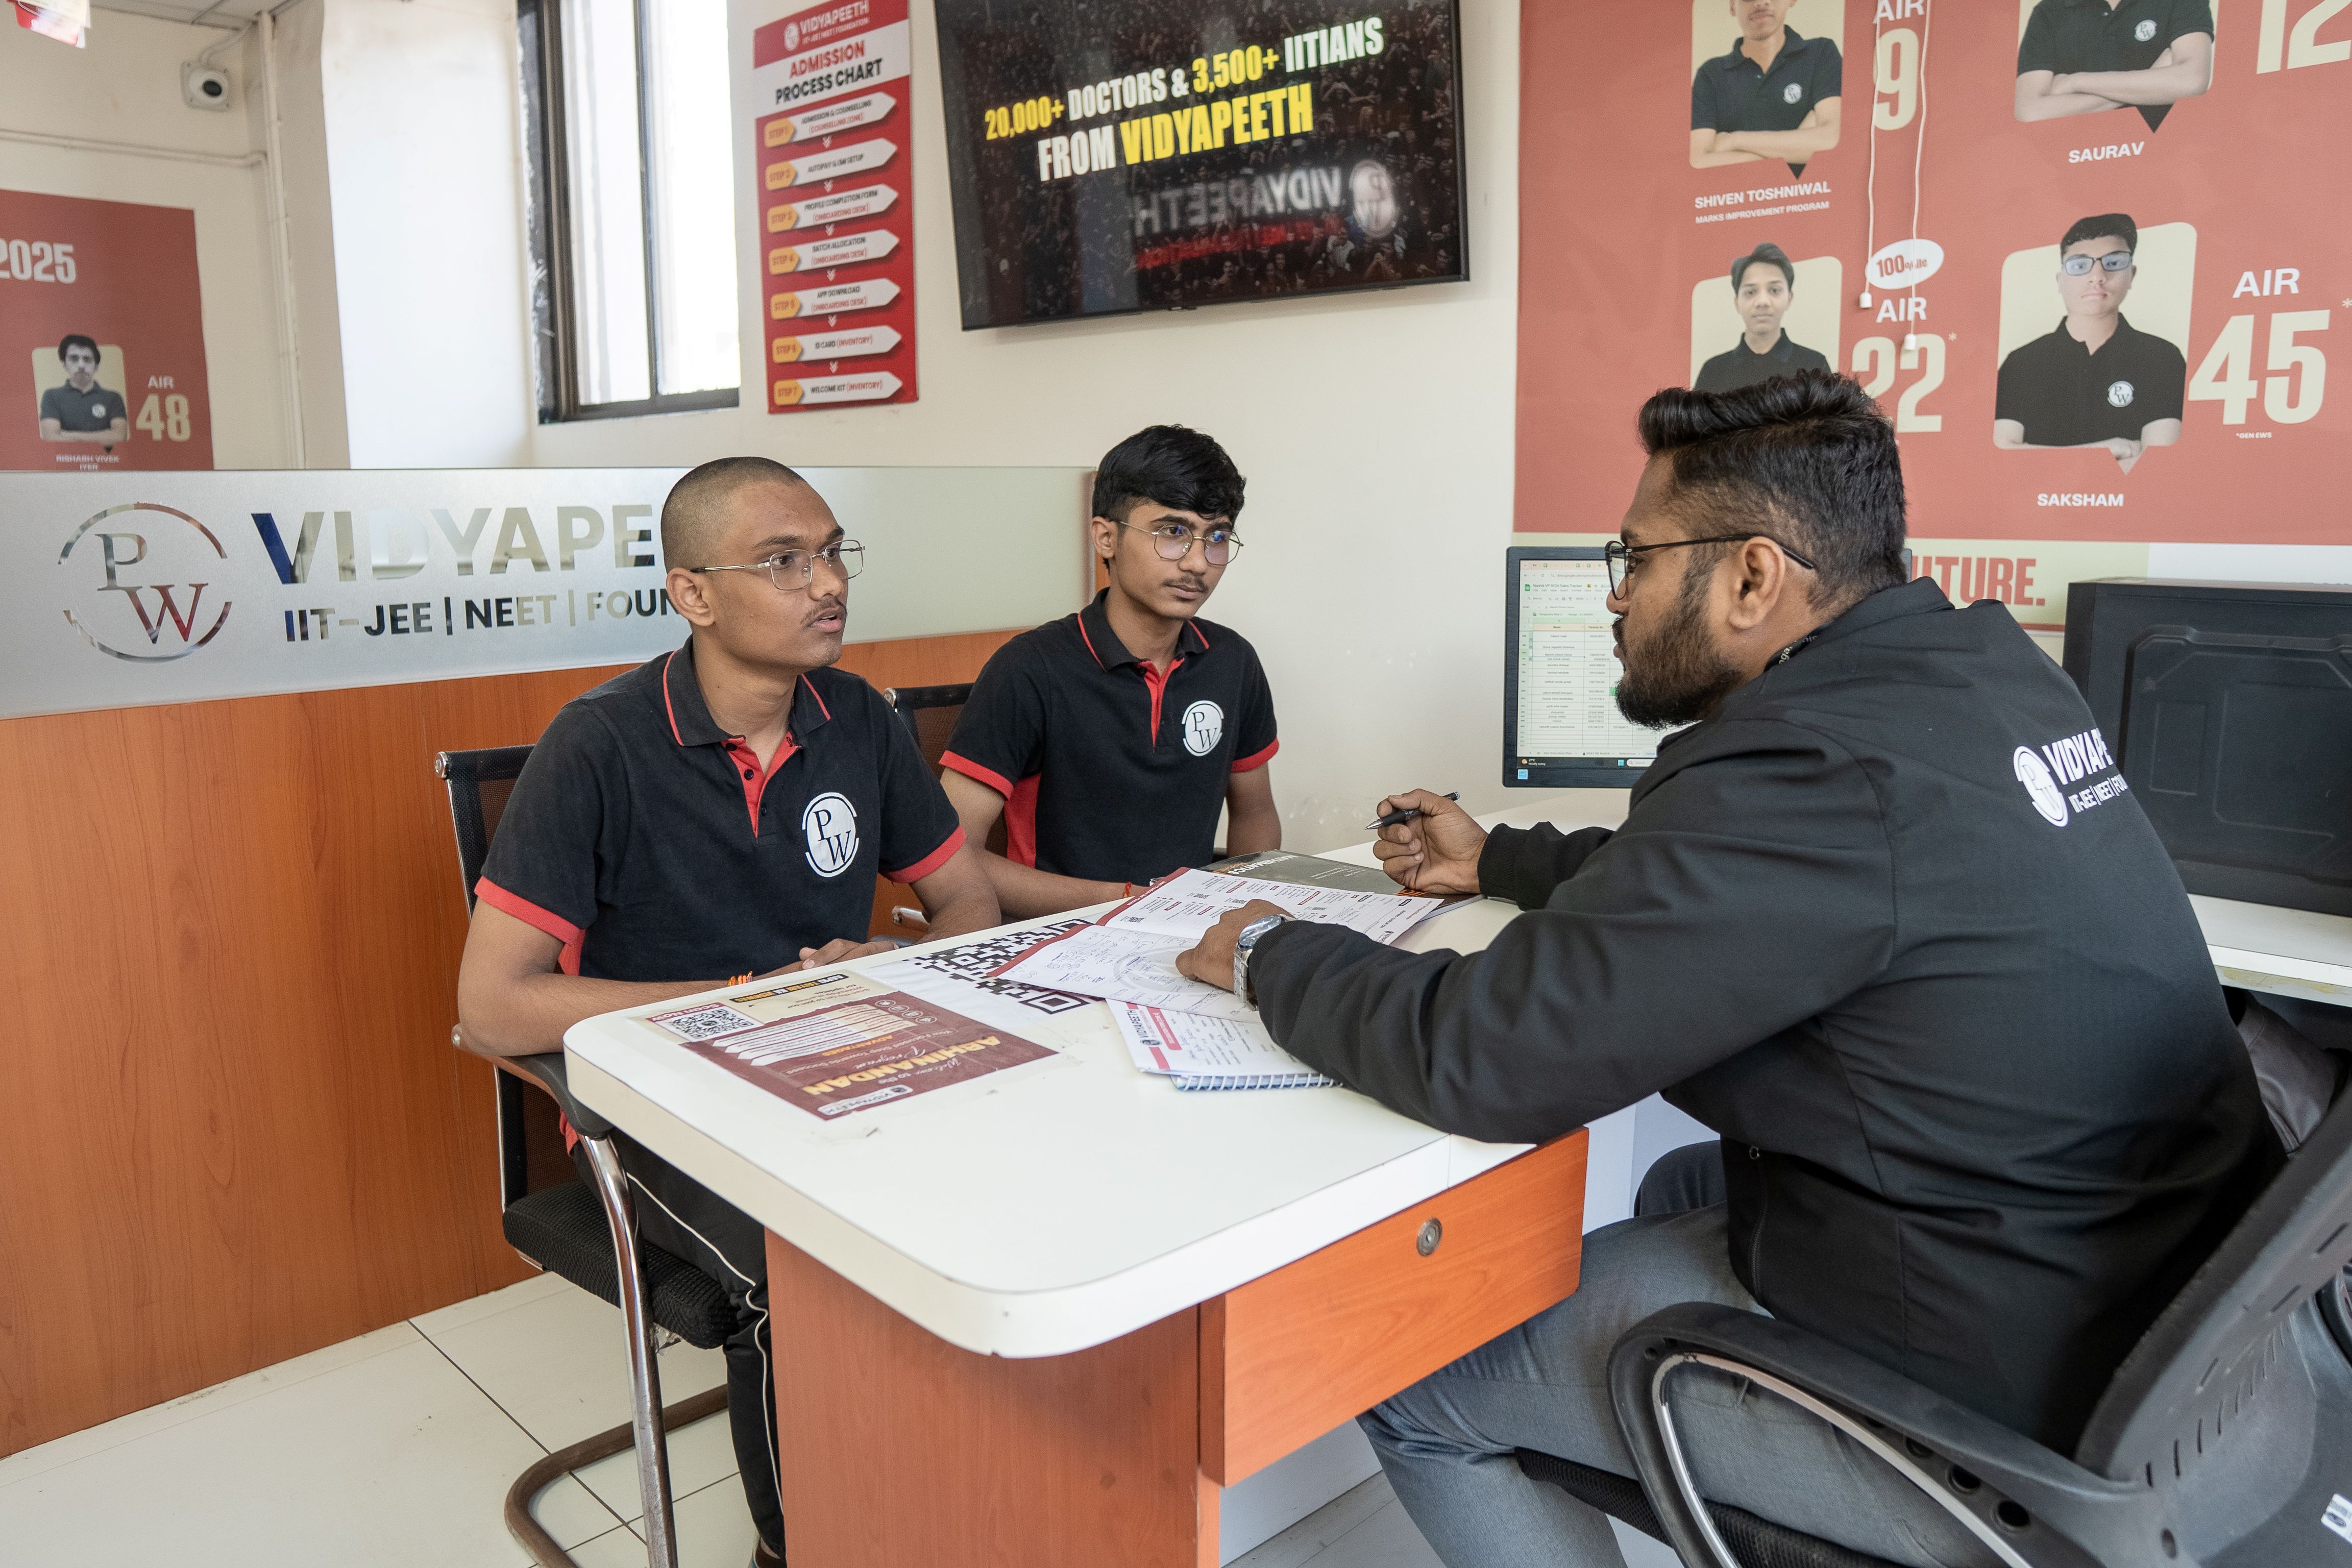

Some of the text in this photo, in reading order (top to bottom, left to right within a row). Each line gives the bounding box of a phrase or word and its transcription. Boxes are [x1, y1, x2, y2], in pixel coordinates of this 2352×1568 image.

[800, 1, 870, 34] VIDYAPEETH
[1873, 0, 1925, 23] AIR
[2256, 0, 2352, 75] 12
[790, 40, 865, 79] ADMISSION
[775, 58, 883, 105] PROCESS CHART
[985, 17, 1384, 140] 20,000+ DOCTORS & 3,500+ IITIANS
[1873, 28, 1919, 131] 9
[835, 100, 872, 115] COUNSELLING
[768, 129, 785, 139] STEP
[1038, 83, 1314, 182] FROM VIDYAPEETH
[2068, 141, 2145, 164] SAURAV
[769, 170, 785, 182] STEP
[1695, 181, 1831, 209] SHIVEN TOSHNIWAL
[770, 213, 786, 225] STEP
[1695, 201, 1830, 224] MARKS IMPROVEMENT PROGRAM
[830, 237, 866, 249] ALLOCATION
[772, 255, 788, 266] STEP
[2232, 268, 2300, 299] AIR
[774, 301, 790, 311] STEP
[1876, 297, 1927, 324] AIR
[776, 345, 791, 355] STEP
[821, 339, 836, 349] CARD
[837, 333, 874, 348] (INVENTORY)
[148, 376, 174, 389] AIR
[778, 388, 792, 398] STEP
[810, 385, 836, 394] WELCOME
[846, 380, 883, 393] (INVENTORY)
[136, 394, 191, 442] 48
[2037, 493, 2124, 508] SAKSHAM
[251, 504, 663, 585] VIDYAPE
[284, 601, 433, 642] IIT-JEE
[465, 594, 557, 630] NEET
[1228, 854, 1298, 875] MATHEMATICS
[820, 974, 843, 984] AAPKI
[822, 1035, 893, 1057] ADVANTAGES
[801, 1035, 1000, 1095] ABHINANDAN
[853, 1046, 926, 1070] Program
